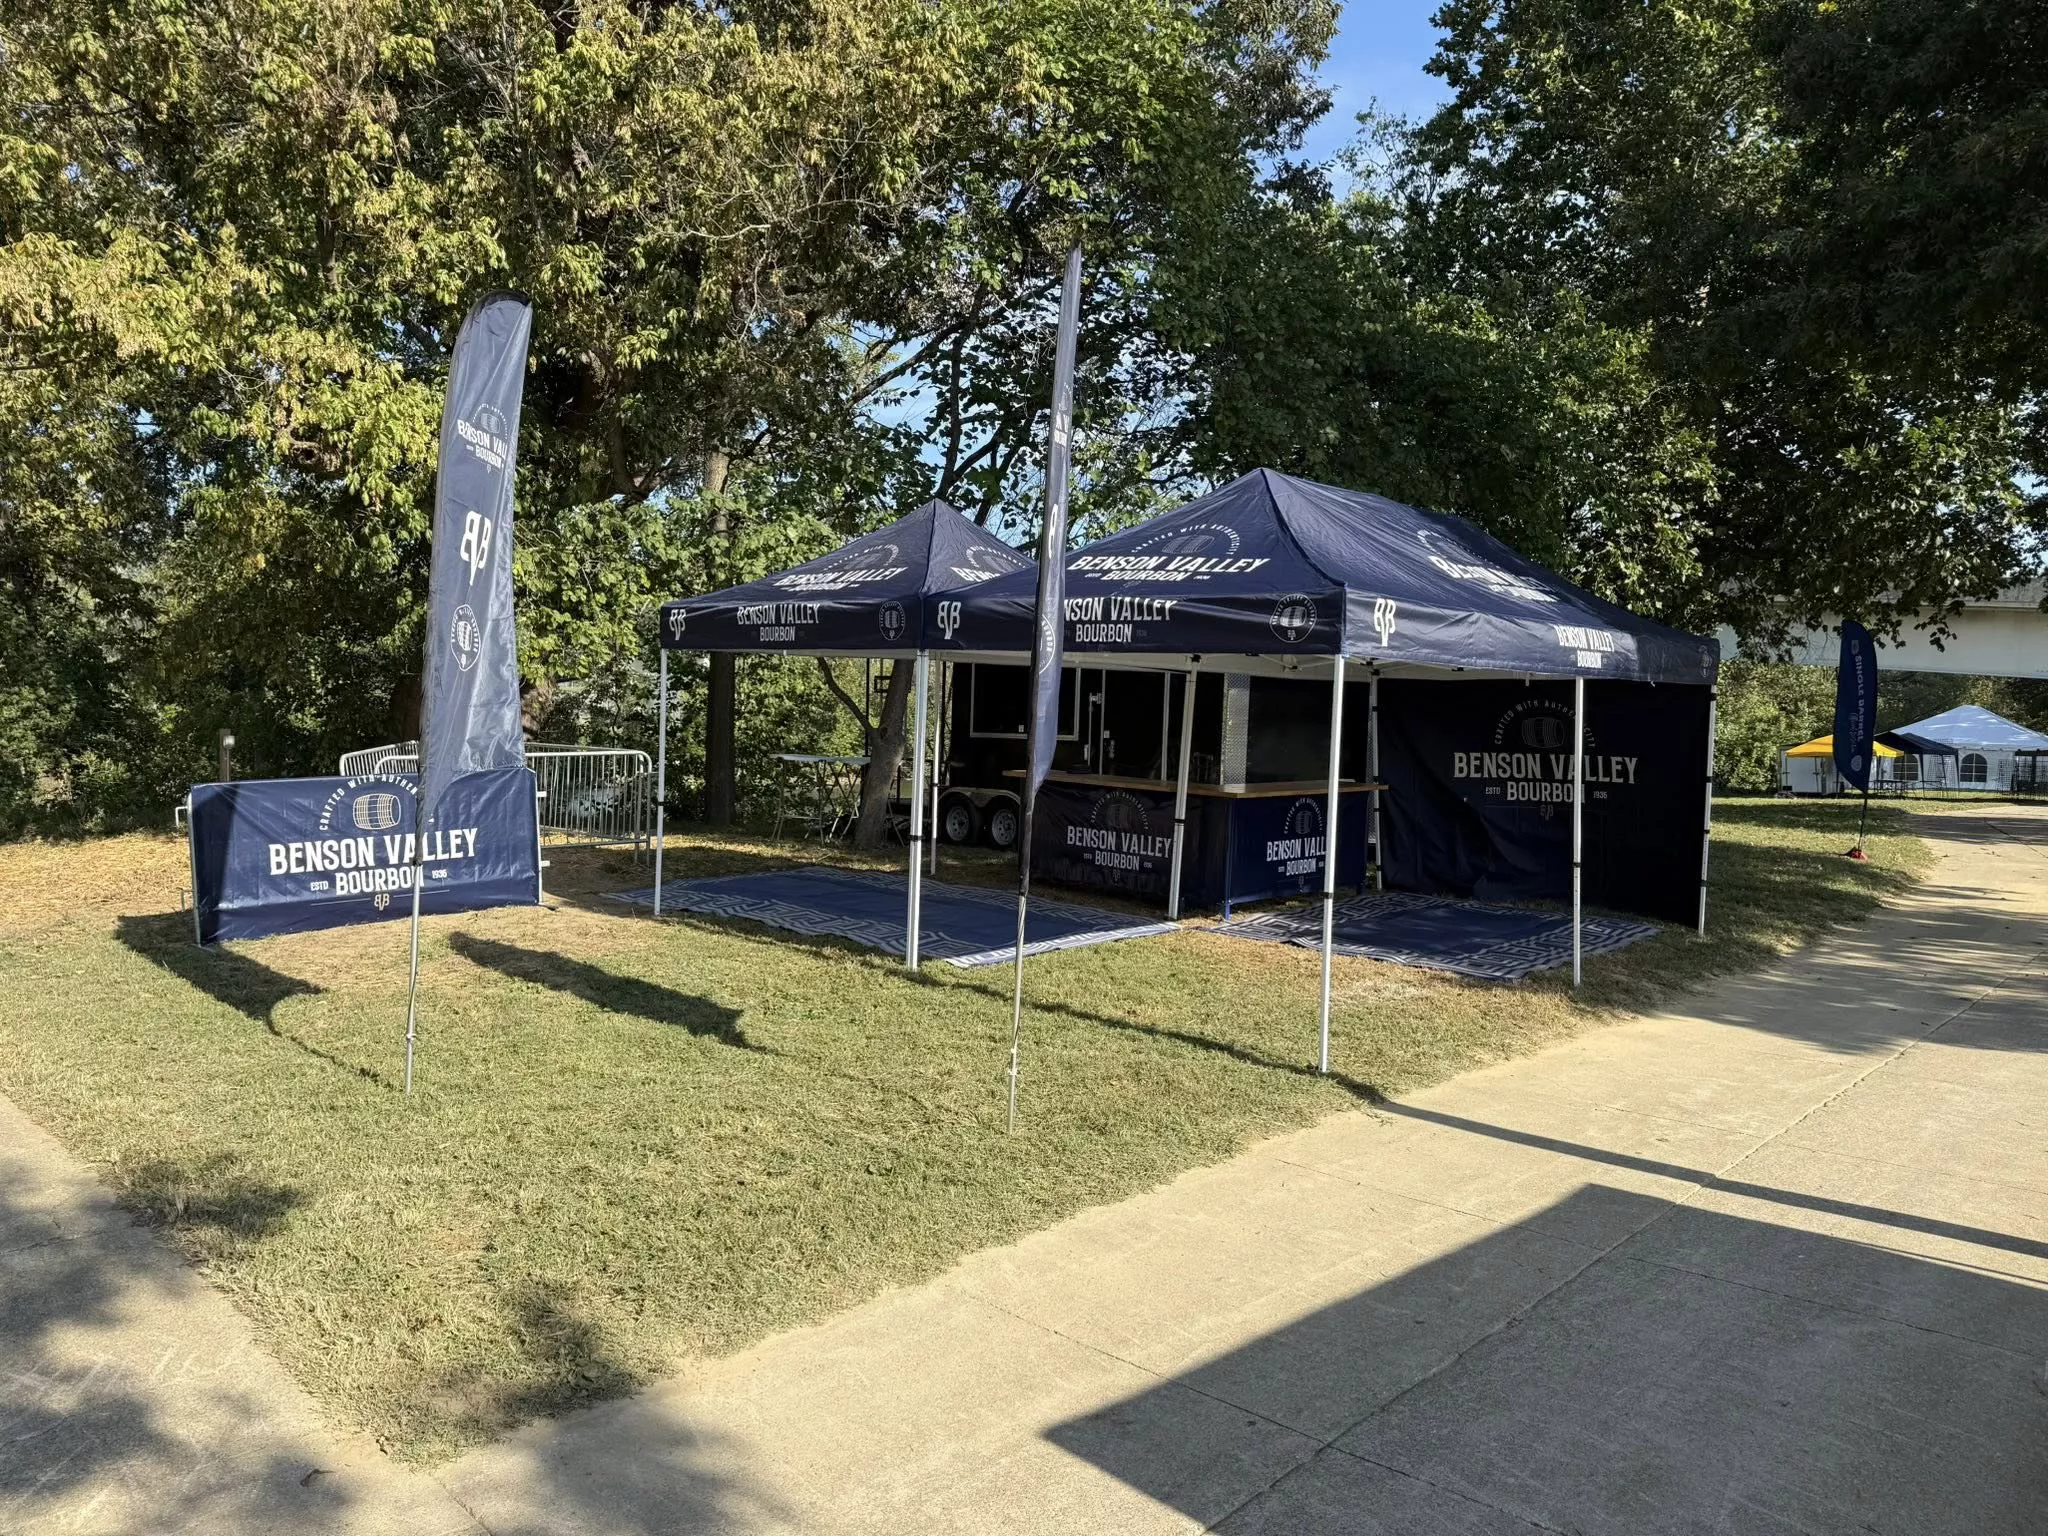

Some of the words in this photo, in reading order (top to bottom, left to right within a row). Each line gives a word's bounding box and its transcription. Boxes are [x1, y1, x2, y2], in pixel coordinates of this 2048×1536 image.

[1067, 555, 1169, 571] BENSON
[1165, 557, 1271, 573] VALLEY
[1100, 570, 1193, 582] BOURBON
[737, 605, 776, 625] BENSON
[779, 603, 821, 624] VALLEY
[1063, 597, 1104, 622] NSON
[1110, 596, 1178, 621] VALLEY
[759, 626, 796, 642] BOURBON
[1075, 623, 1133, 643] BOURBON
[1556, 624, 1588, 649] BENSON
[1515, 699, 1539, 712] WITH
[1453, 752, 1543, 780] BENSON
[319, 787, 345, 831] CRAFTED
[347, 773, 375, 789] WITH
[1066, 825, 1117, 851] BENSON
[1121, 832, 1173, 859] VALLEY
[1266, 838, 1302, 861] BENSON
[1304, 836, 1328, 858] VALL
[268, 836, 375, 876] BENSON
[1095, 850, 1140, 871] BOURBON
[1286, 858, 1317, 876] BOURBON
[310, 880, 329, 892] ESTD
